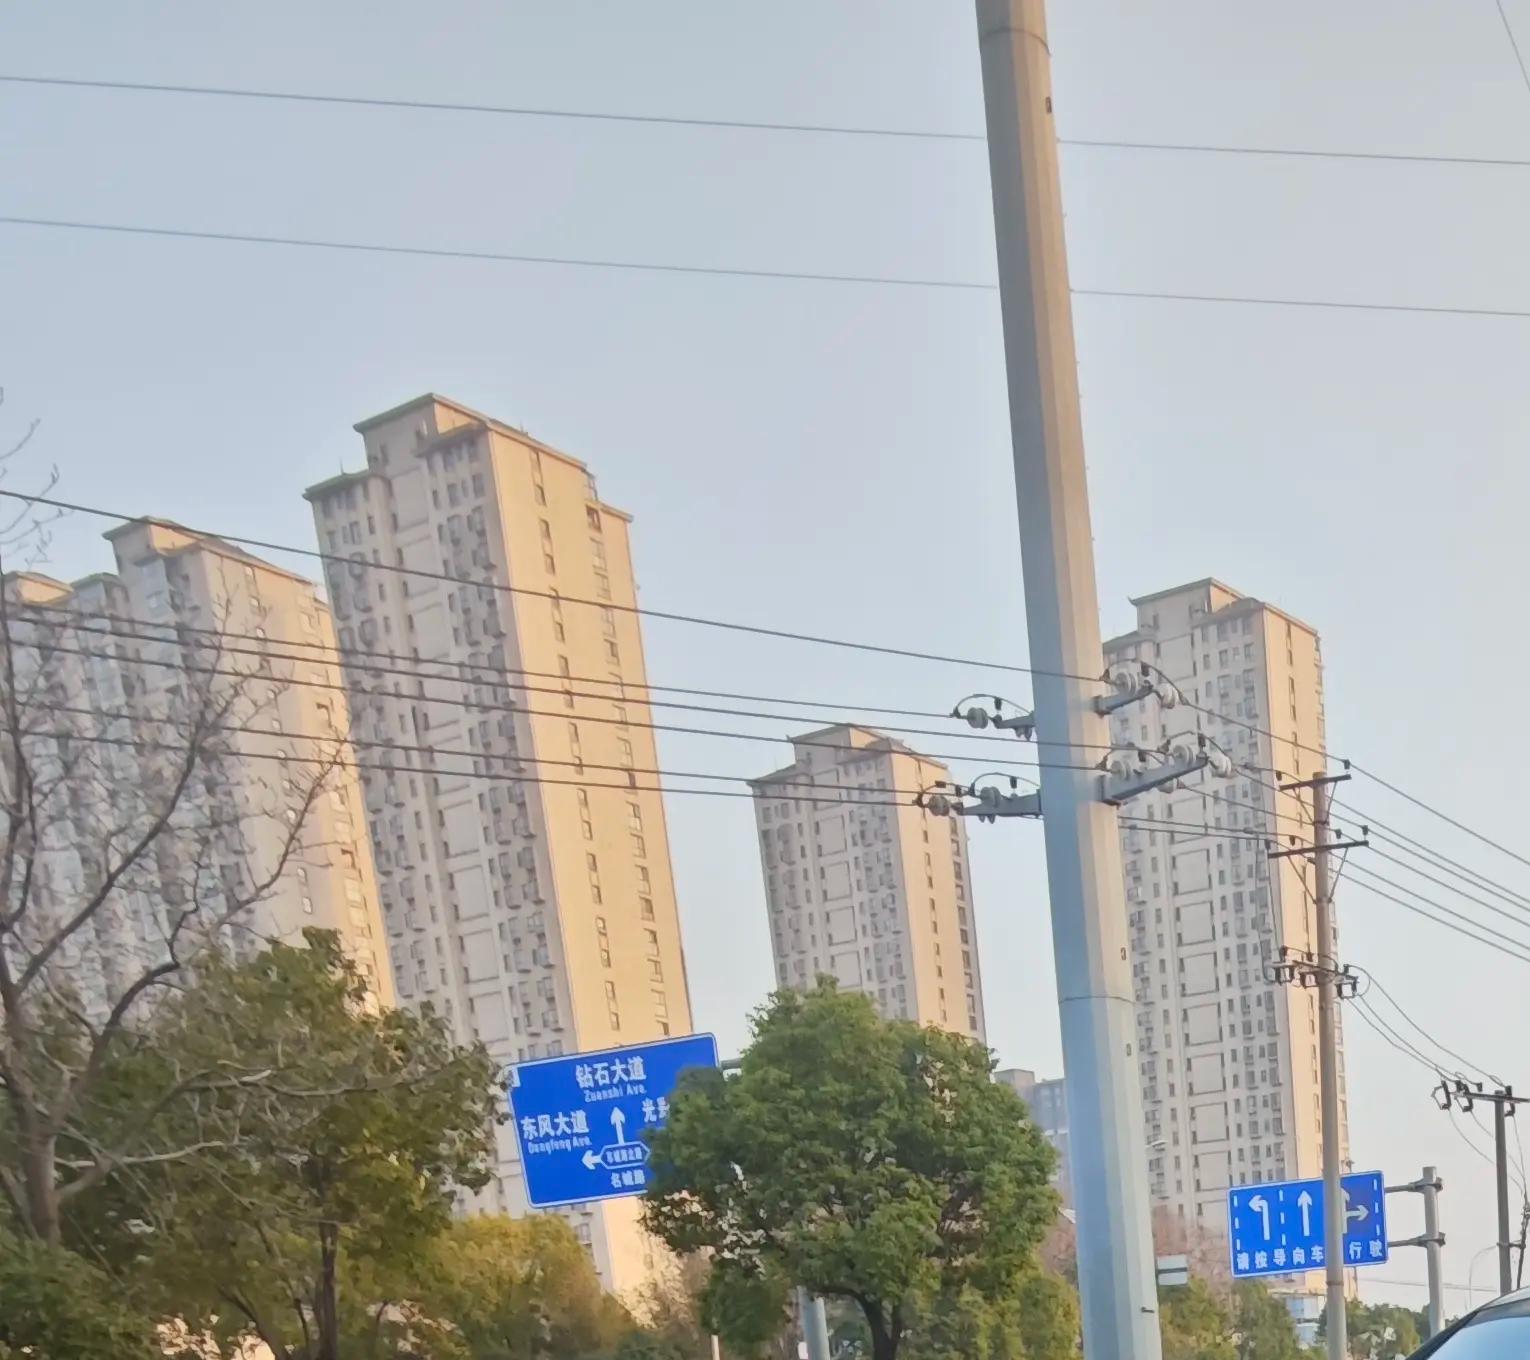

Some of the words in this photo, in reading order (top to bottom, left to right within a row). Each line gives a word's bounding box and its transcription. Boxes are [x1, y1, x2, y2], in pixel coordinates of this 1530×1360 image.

[576, 1056, 647, 1089] 钻石大道
[520, 1110, 589, 1140] 东风大道
[1237, 1240, 1383, 1270] 请按导向车行驶
